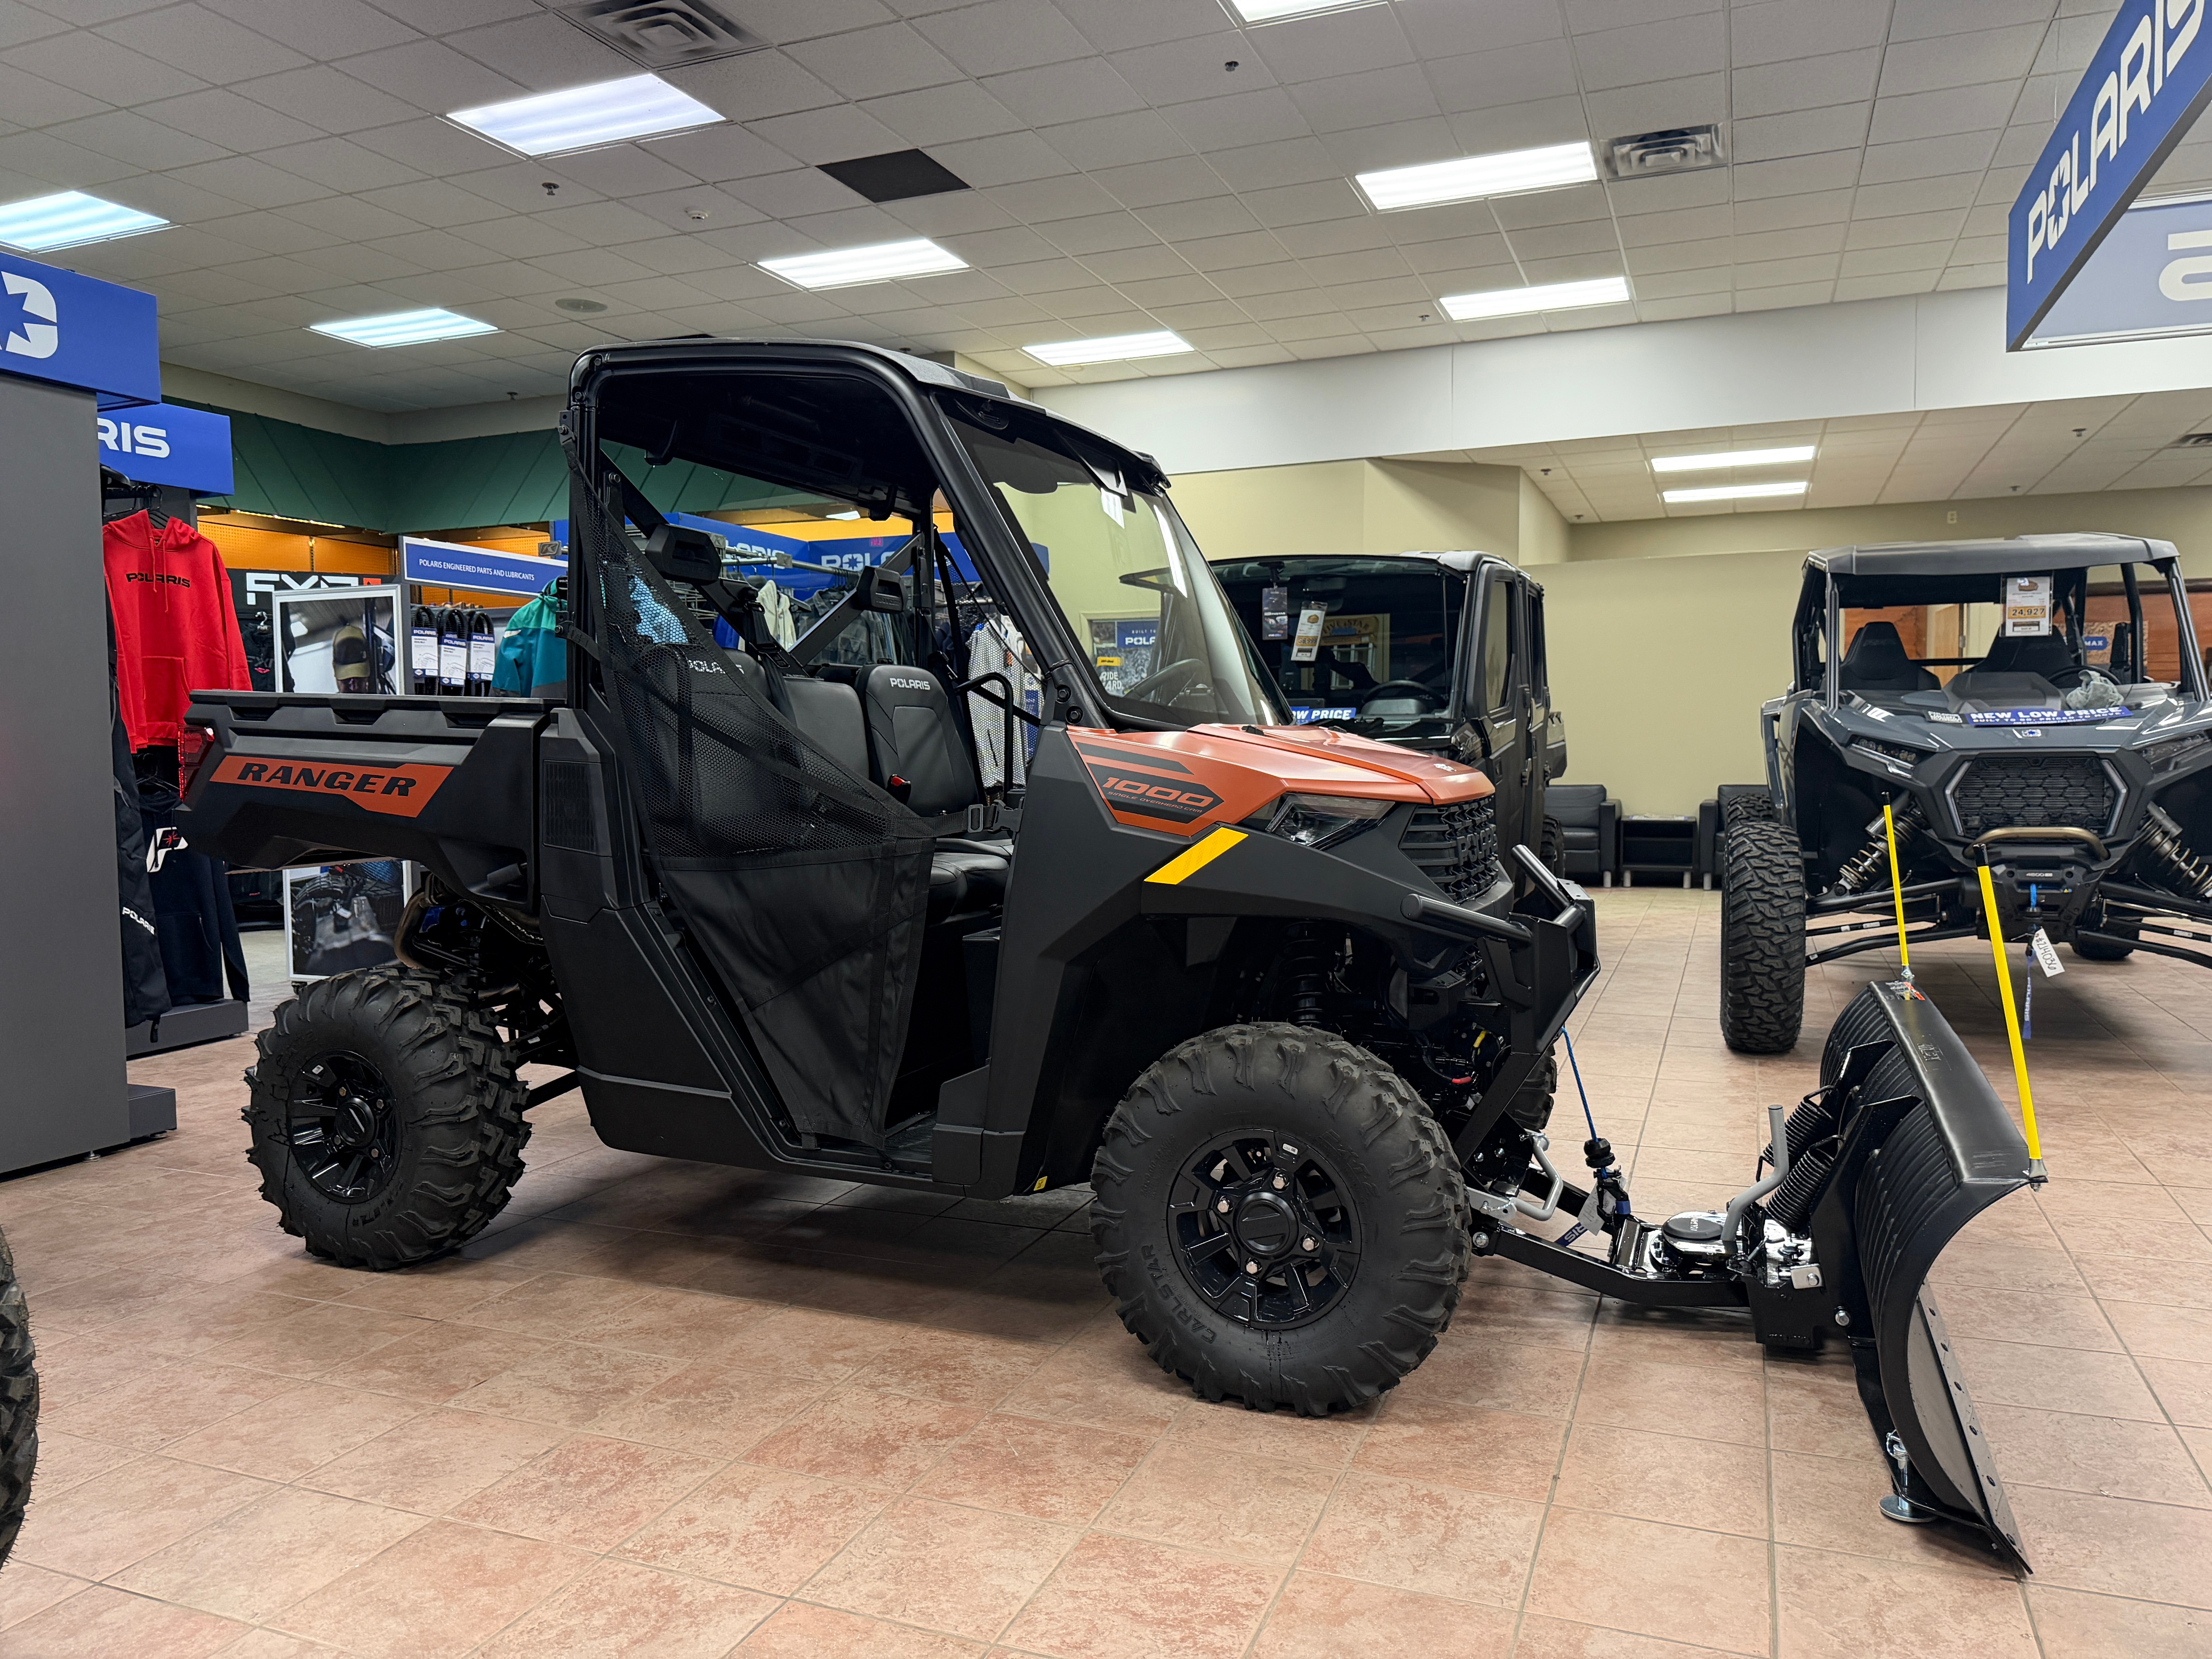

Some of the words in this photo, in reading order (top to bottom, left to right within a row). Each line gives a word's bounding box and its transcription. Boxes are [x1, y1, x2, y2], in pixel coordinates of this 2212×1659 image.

[419, 559, 443, 568] POLARIS
[443, 562, 476, 573] ENGINEERED
[477, 567, 493, 575] PARTS
[505, 571, 535, 581] LUBRICANTS
[125, 572, 191, 588] POLARIS
[890, 678, 931, 690] POLARIS
[1099, 672, 1119, 681] RIDE
[1311, 709, 1352, 720] PRICE
[2064, 707, 2123, 716] PRICE
[237, 763, 417, 797] RANGER
[1102, 777, 1214, 807] 1000
[1107, 791, 1138, 800] SINGLE
[1140, 798, 1183, 809] OVERHEAD
[122, 907, 155, 935] POLARIS
[1141, 1244, 1217, 1344] CARLSTAR
